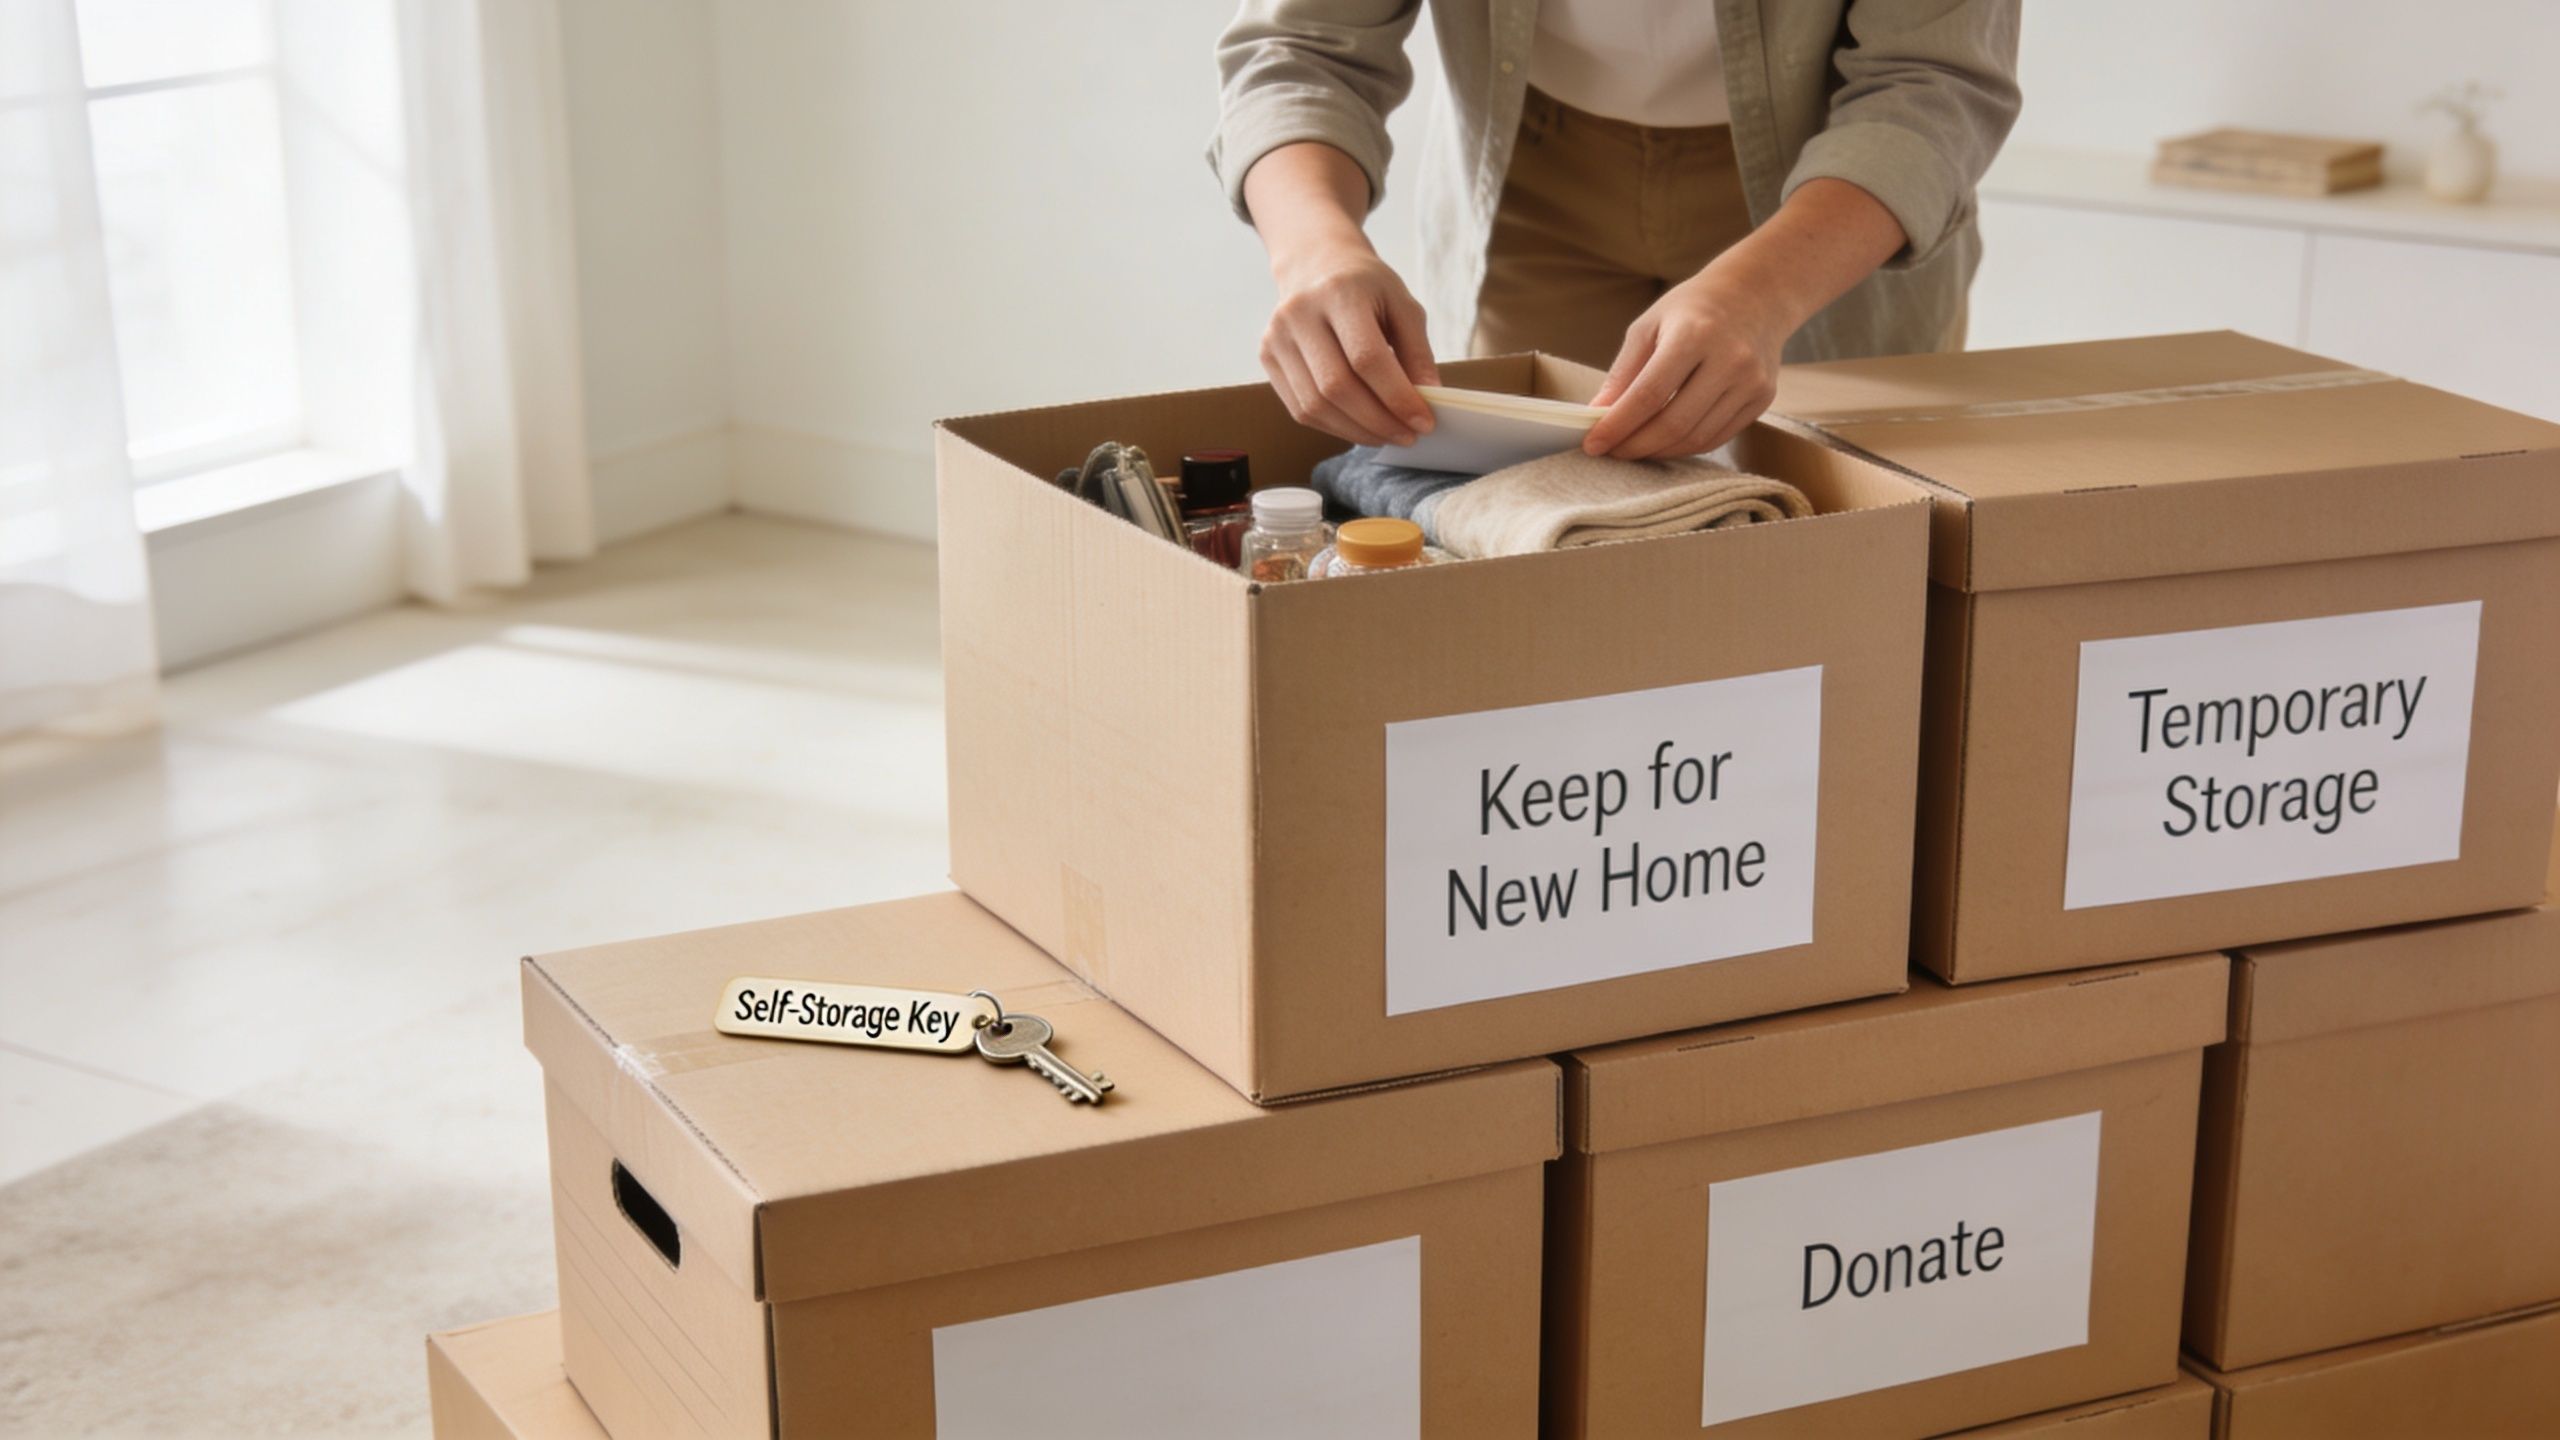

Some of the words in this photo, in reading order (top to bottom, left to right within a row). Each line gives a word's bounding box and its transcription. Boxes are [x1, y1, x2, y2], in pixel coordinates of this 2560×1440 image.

[2128, 675, 2427, 757] Temporary
[1481, 763, 1628, 837] Keep
[1647, 740, 1733, 810] for
[2163, 769, 2379, 837] Storage
[1448, 864, 1579, 937] New
[1602, 841, 1766, 912] Home
[734, 989, 900, 1039] Self-Storage
[907, 1000, 960, 1044] Key
[1801, 1220, 2005, 1310] Donate
